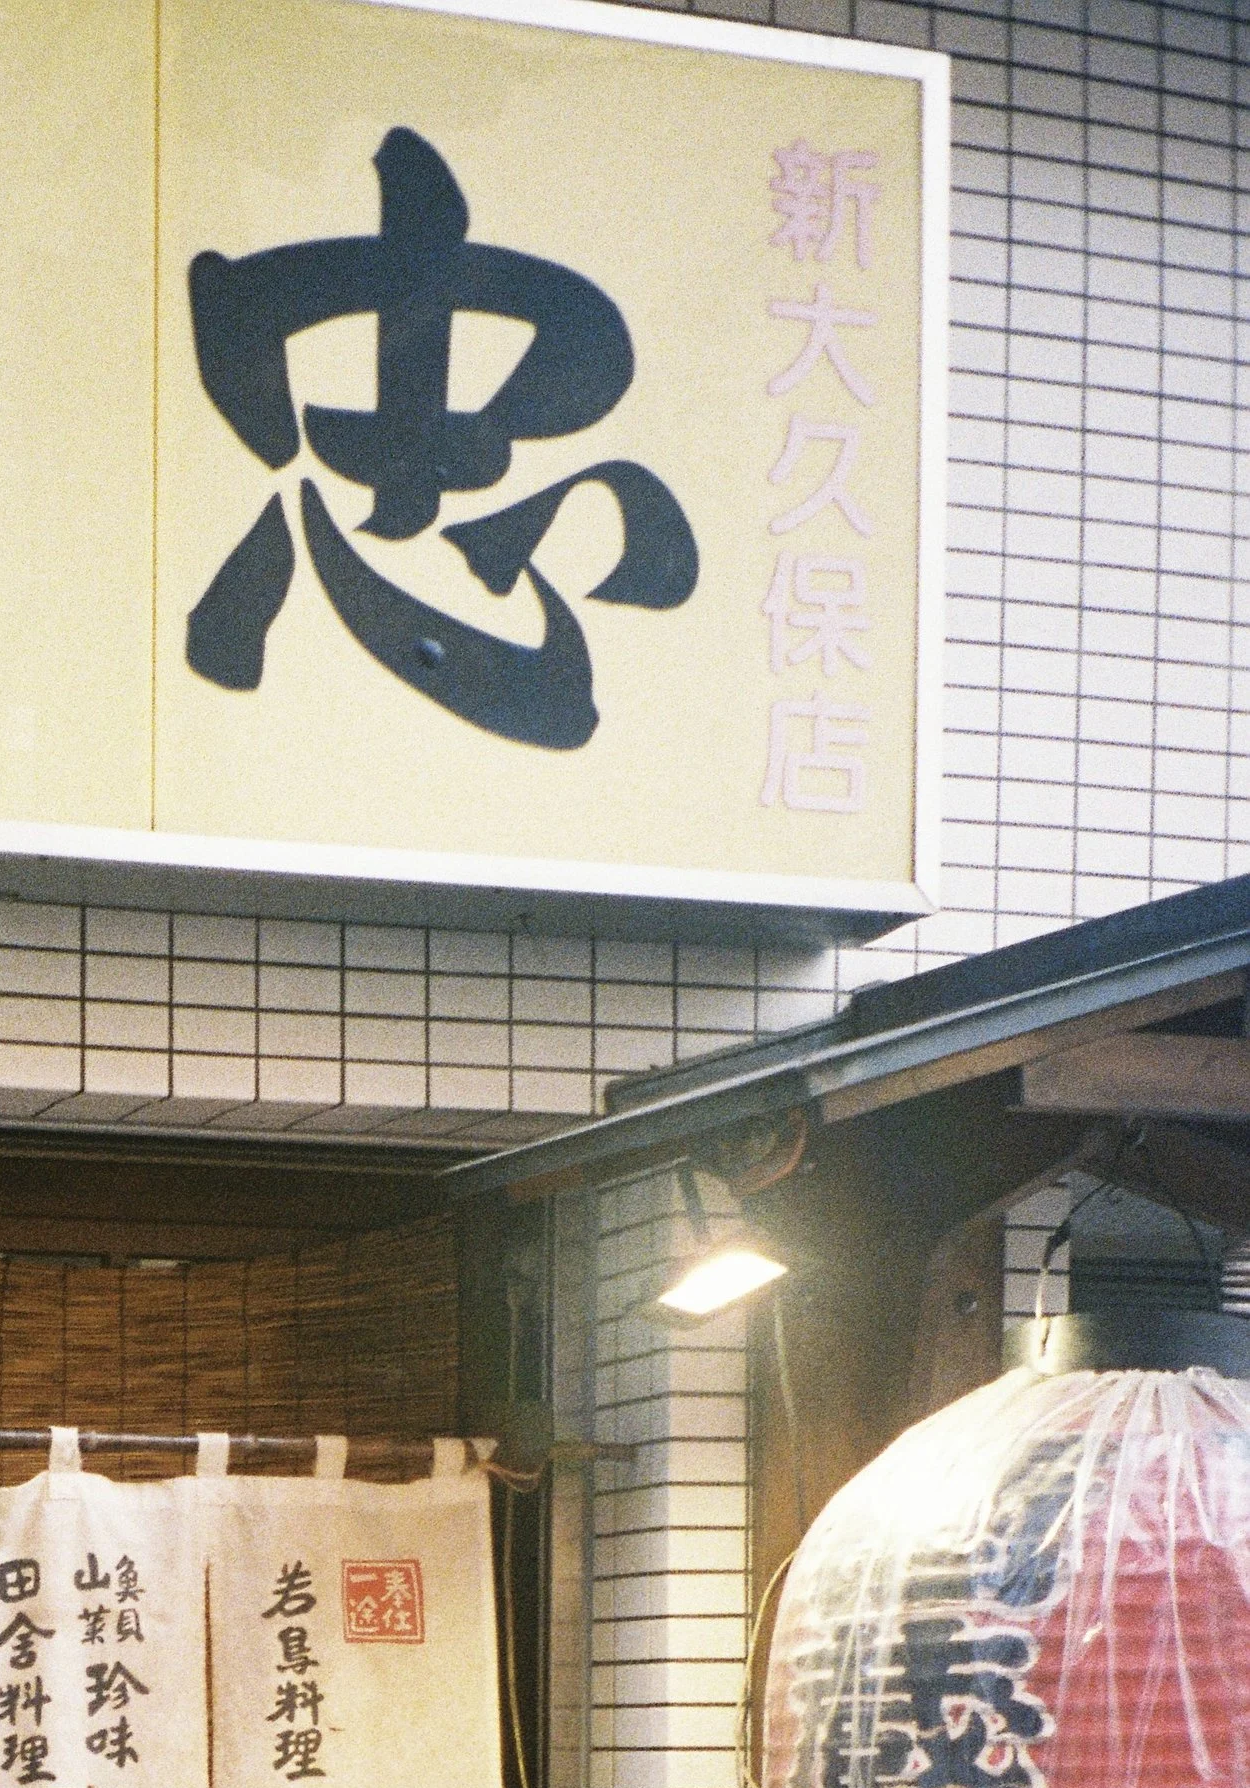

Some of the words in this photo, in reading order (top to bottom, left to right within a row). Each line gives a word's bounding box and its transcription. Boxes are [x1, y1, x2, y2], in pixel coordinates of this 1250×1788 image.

[760, 138, 882, 816] 新大久保店
[85, 1661, 150, 1768] 珍味
[261, 1560, 327, 1781] 若鳥料理
